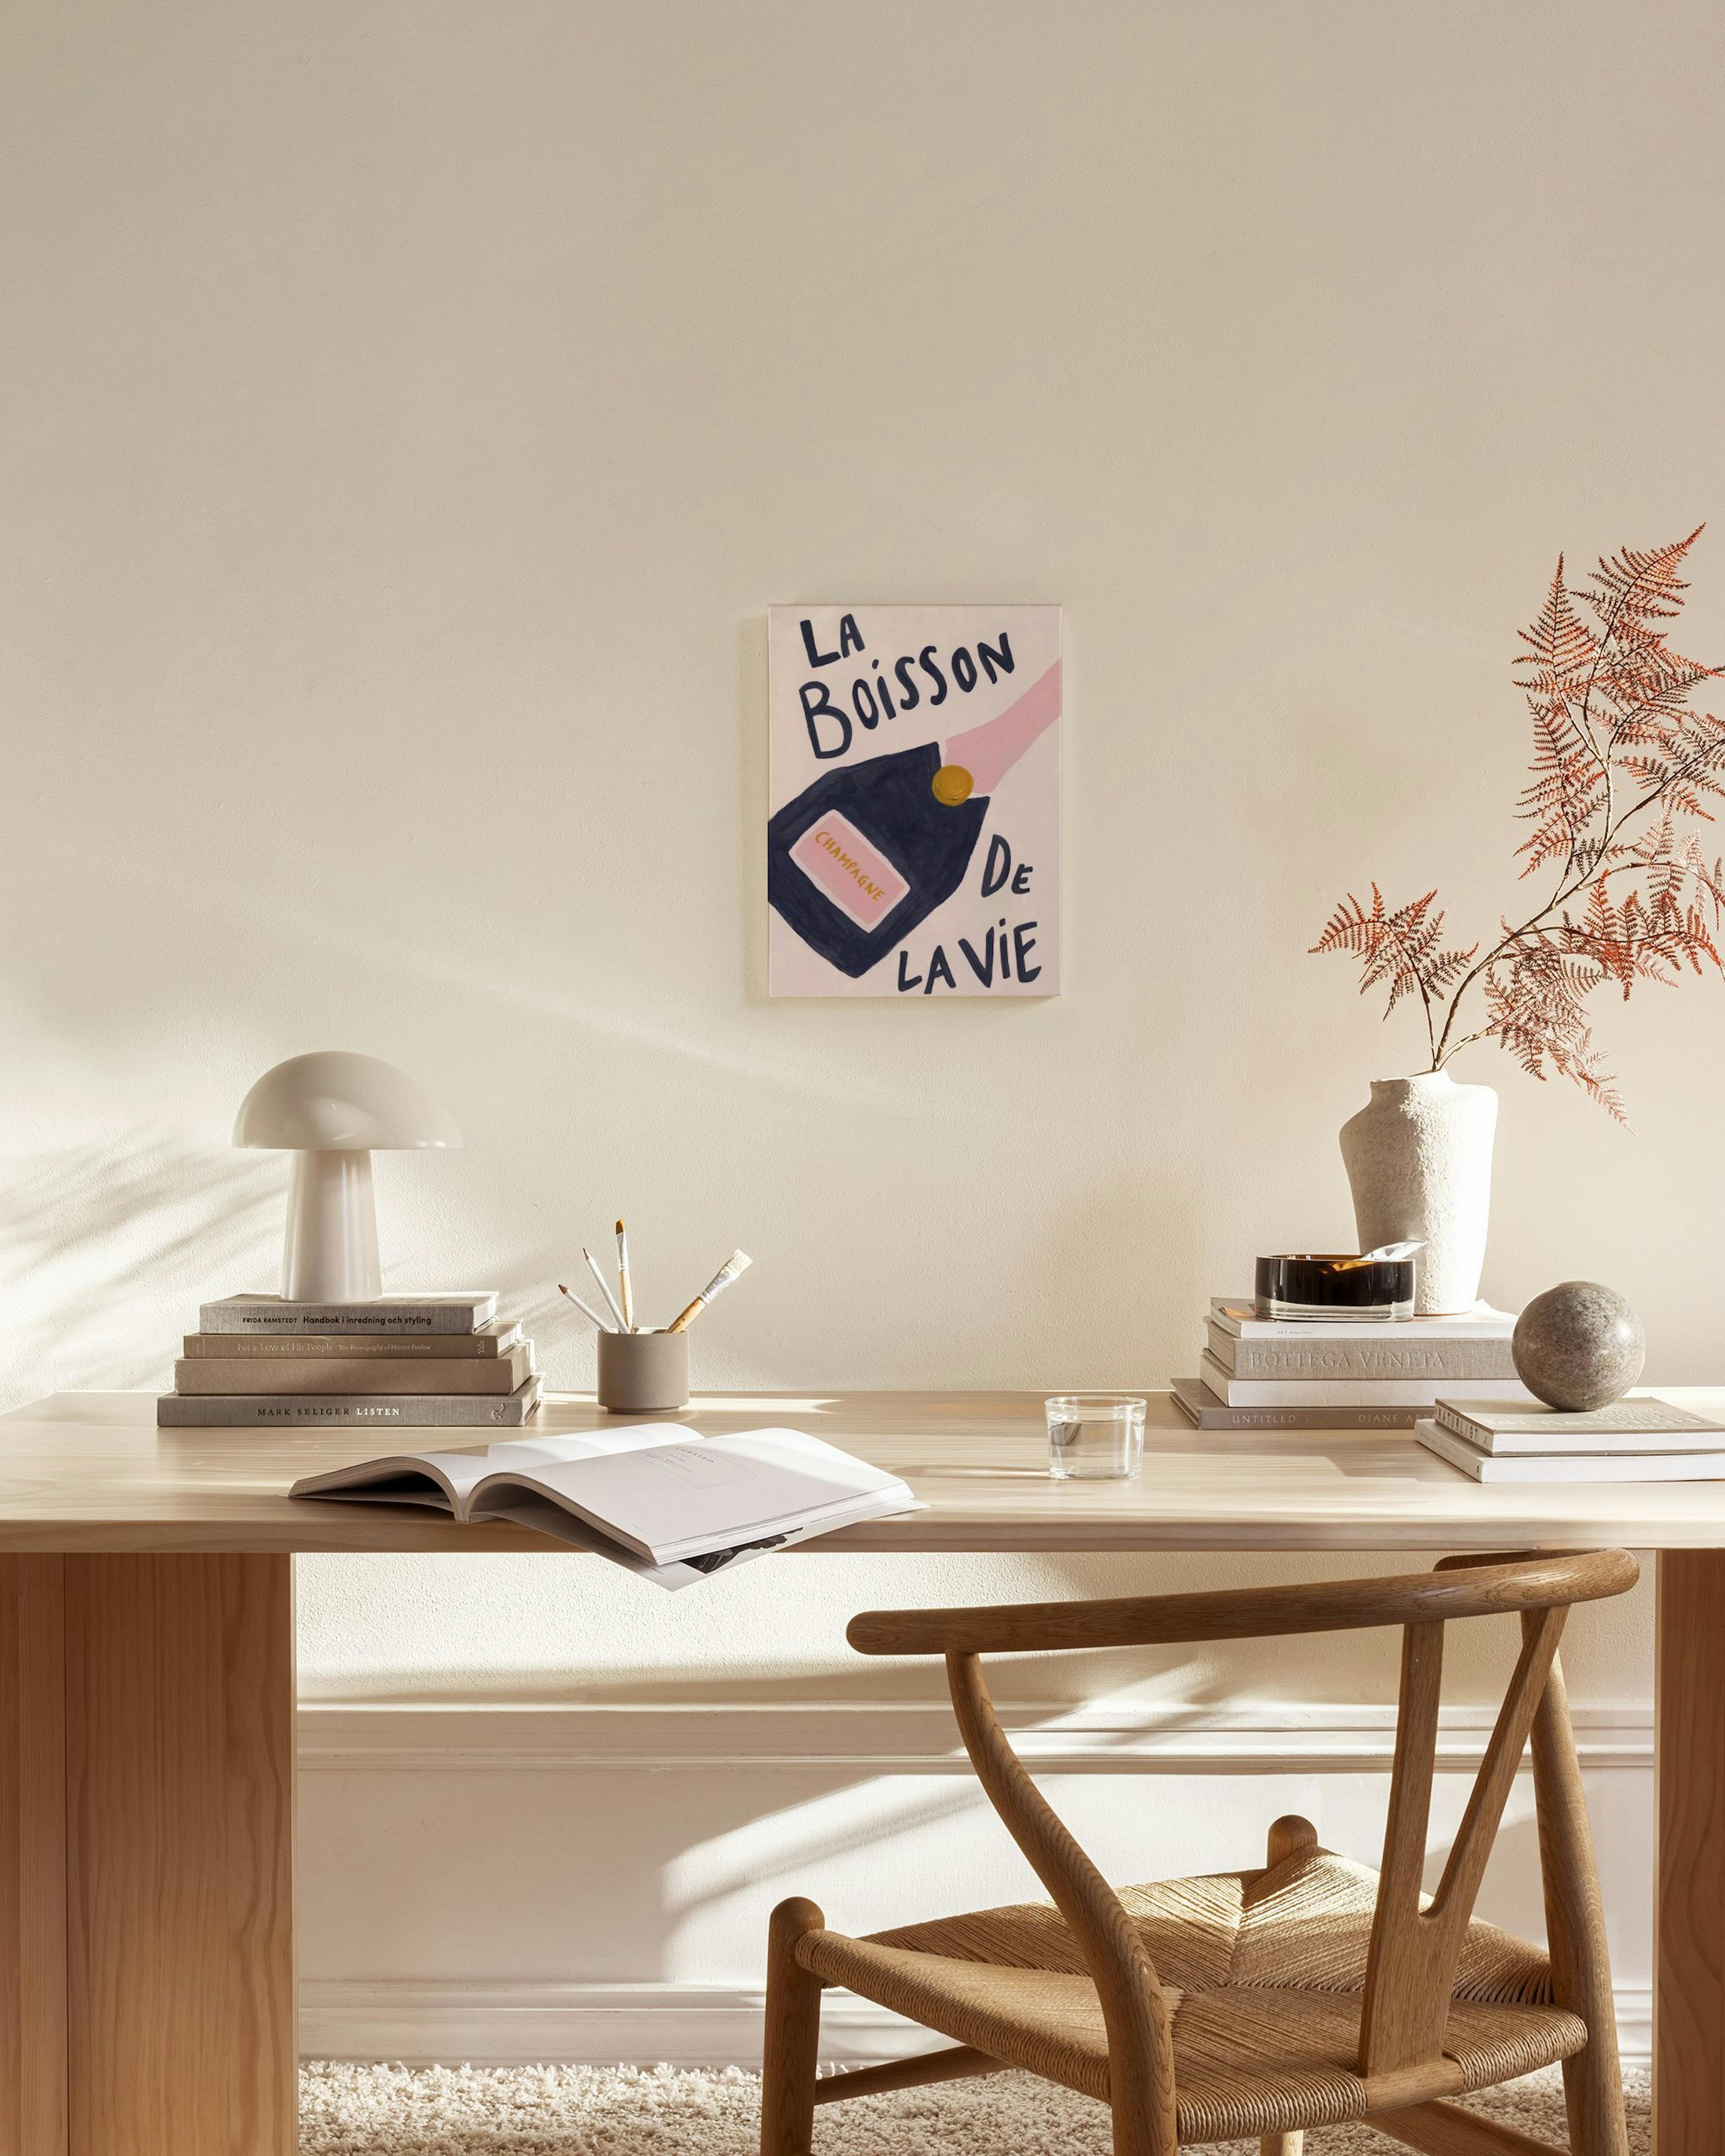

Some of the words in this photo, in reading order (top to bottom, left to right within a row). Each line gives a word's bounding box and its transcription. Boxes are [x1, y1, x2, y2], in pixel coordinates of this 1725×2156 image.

[800, 614, 865, 668] LA
[815, 832, 885, 901] CHAMPAGNE
[981, 834, 1033, 898] DE
[898, 945, 956, 994] LA
[346, 1316, 385, 1326] inredning
[404, 1316, 432, 1326] styling
[307, 1343, 334, 1353] People
[1250, 1352, 1351, 1368] BOTTEGA
[1359, 1352, 1446, 1368] VENETA
[357, 1408, 400, 1416] LISTEN
[1232, 1414, 1296, 1423] UNTITLED
[1358, 1414, 1398, 1423] DIANE
